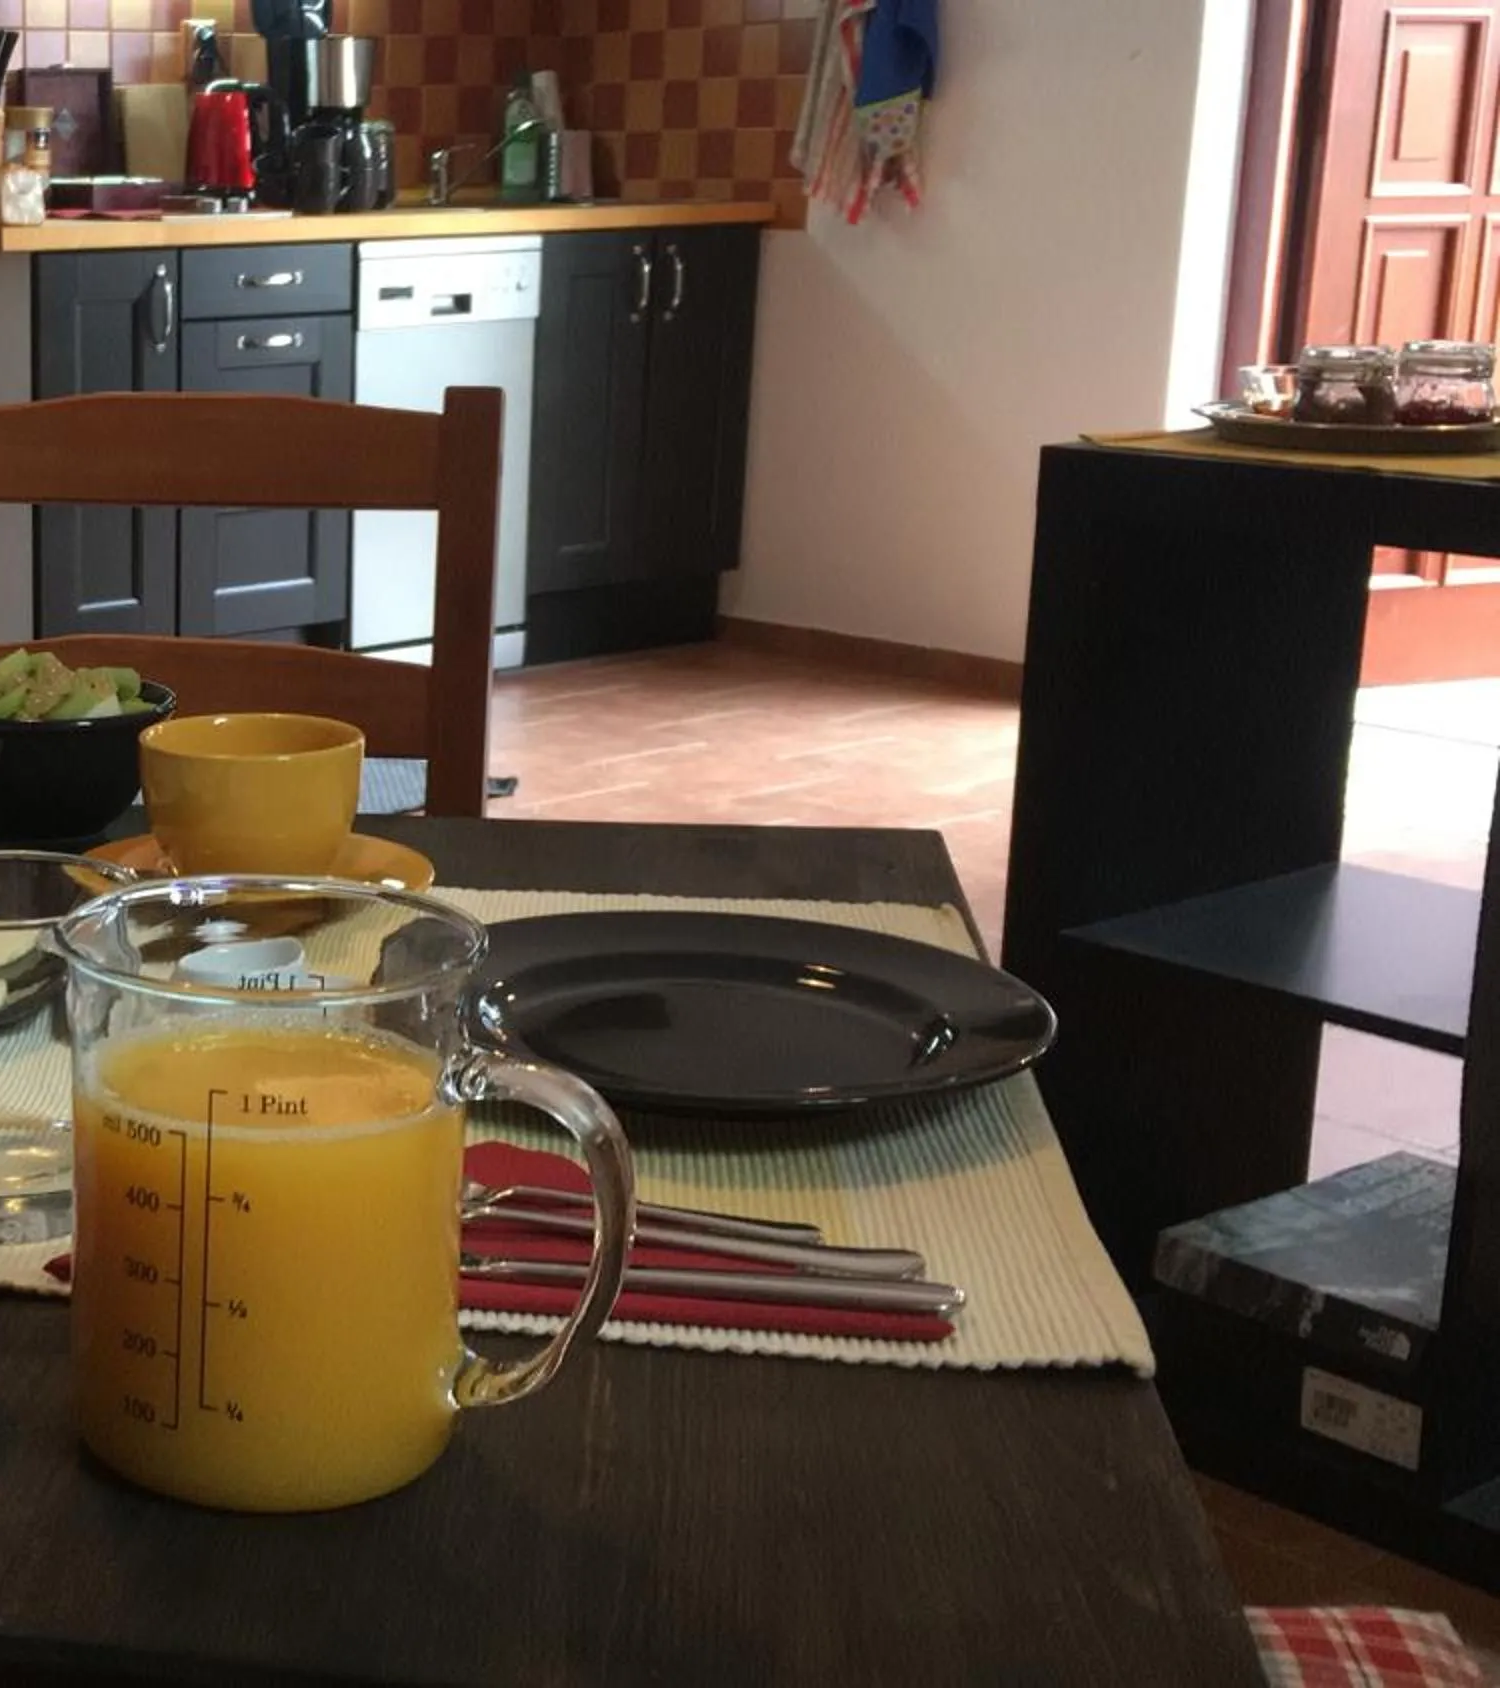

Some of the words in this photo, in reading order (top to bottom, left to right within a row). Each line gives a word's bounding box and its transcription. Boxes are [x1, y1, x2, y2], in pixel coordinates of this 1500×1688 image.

[241, 1093, 251, 1113] 1
[259, 1094, 309, 1116] Pint
[126, 1119, 162, 1147] 500
[125, 1183, 160, 1213] 400
